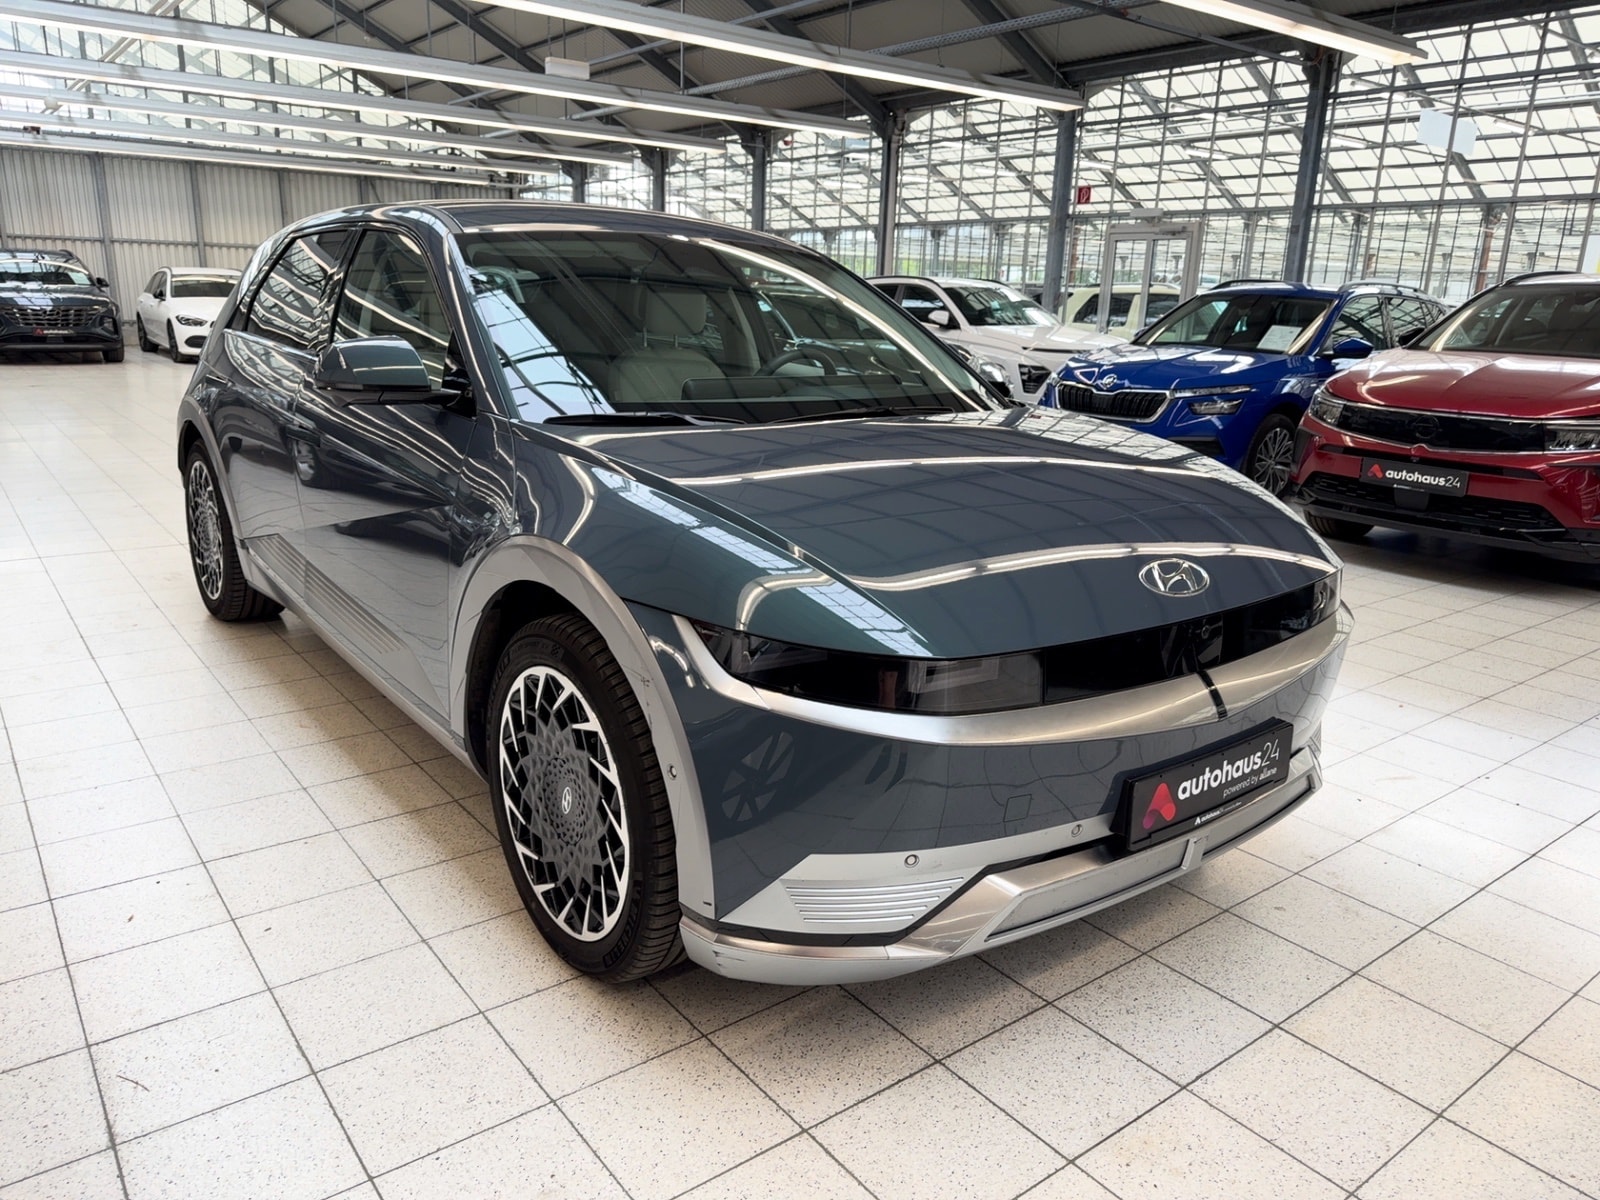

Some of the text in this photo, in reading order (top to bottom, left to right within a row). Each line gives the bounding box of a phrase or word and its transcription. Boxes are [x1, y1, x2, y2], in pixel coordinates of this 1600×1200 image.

[1385, 470, 1461, 488] autohaus24
[1177, 739, 1280, 800] autohaus24
[1223, 777, 1250, 799] powered
[1250, 775, 1259, 785] by
